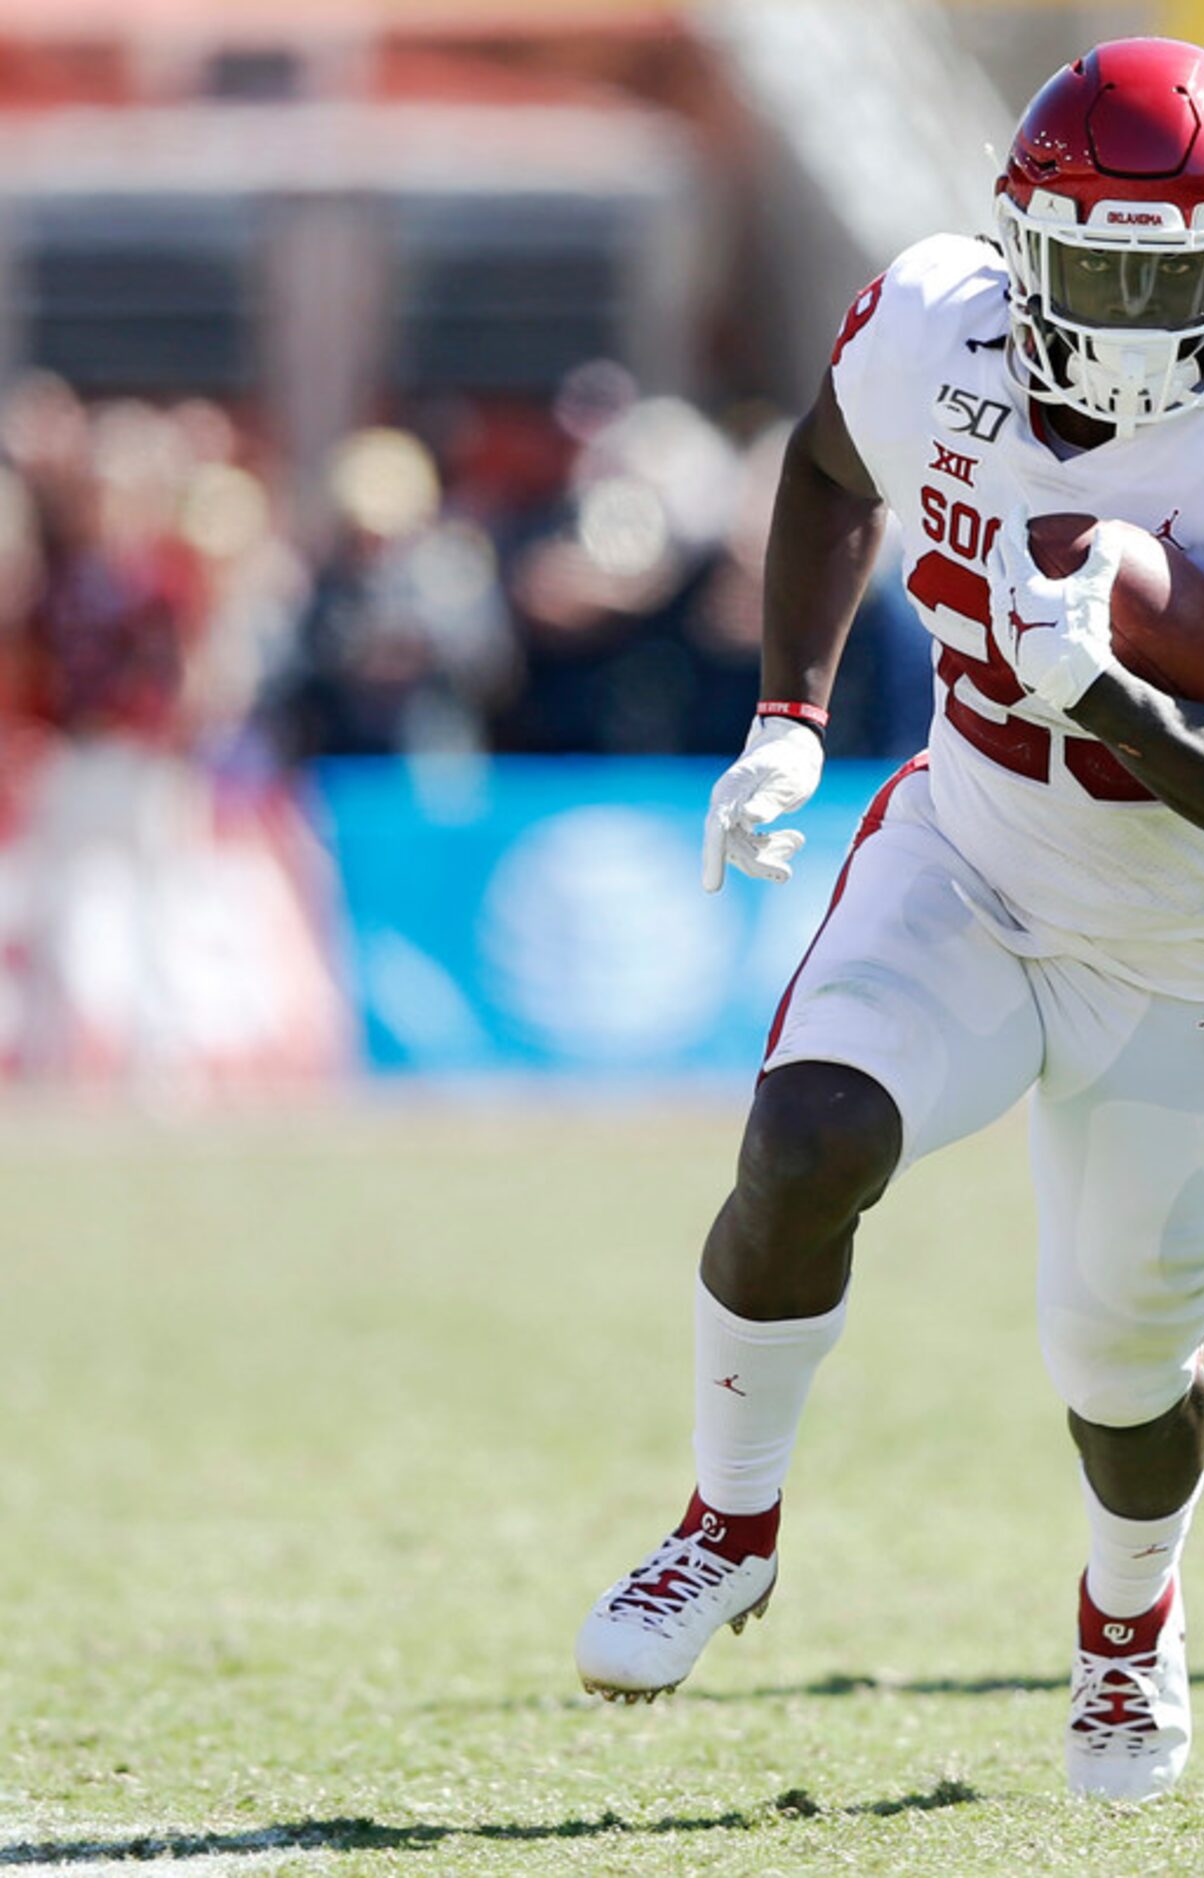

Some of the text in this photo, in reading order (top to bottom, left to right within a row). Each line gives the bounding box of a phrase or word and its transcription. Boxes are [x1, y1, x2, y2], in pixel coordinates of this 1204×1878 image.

[1107, 211, 1163, 226] OKLAHOMA
[936, 385, 1012, 443] 150
[928, 440, 979, 488] XII
[907, 549, 1160, 801] 2
[1102, 1623, 1135, 1645] OU
